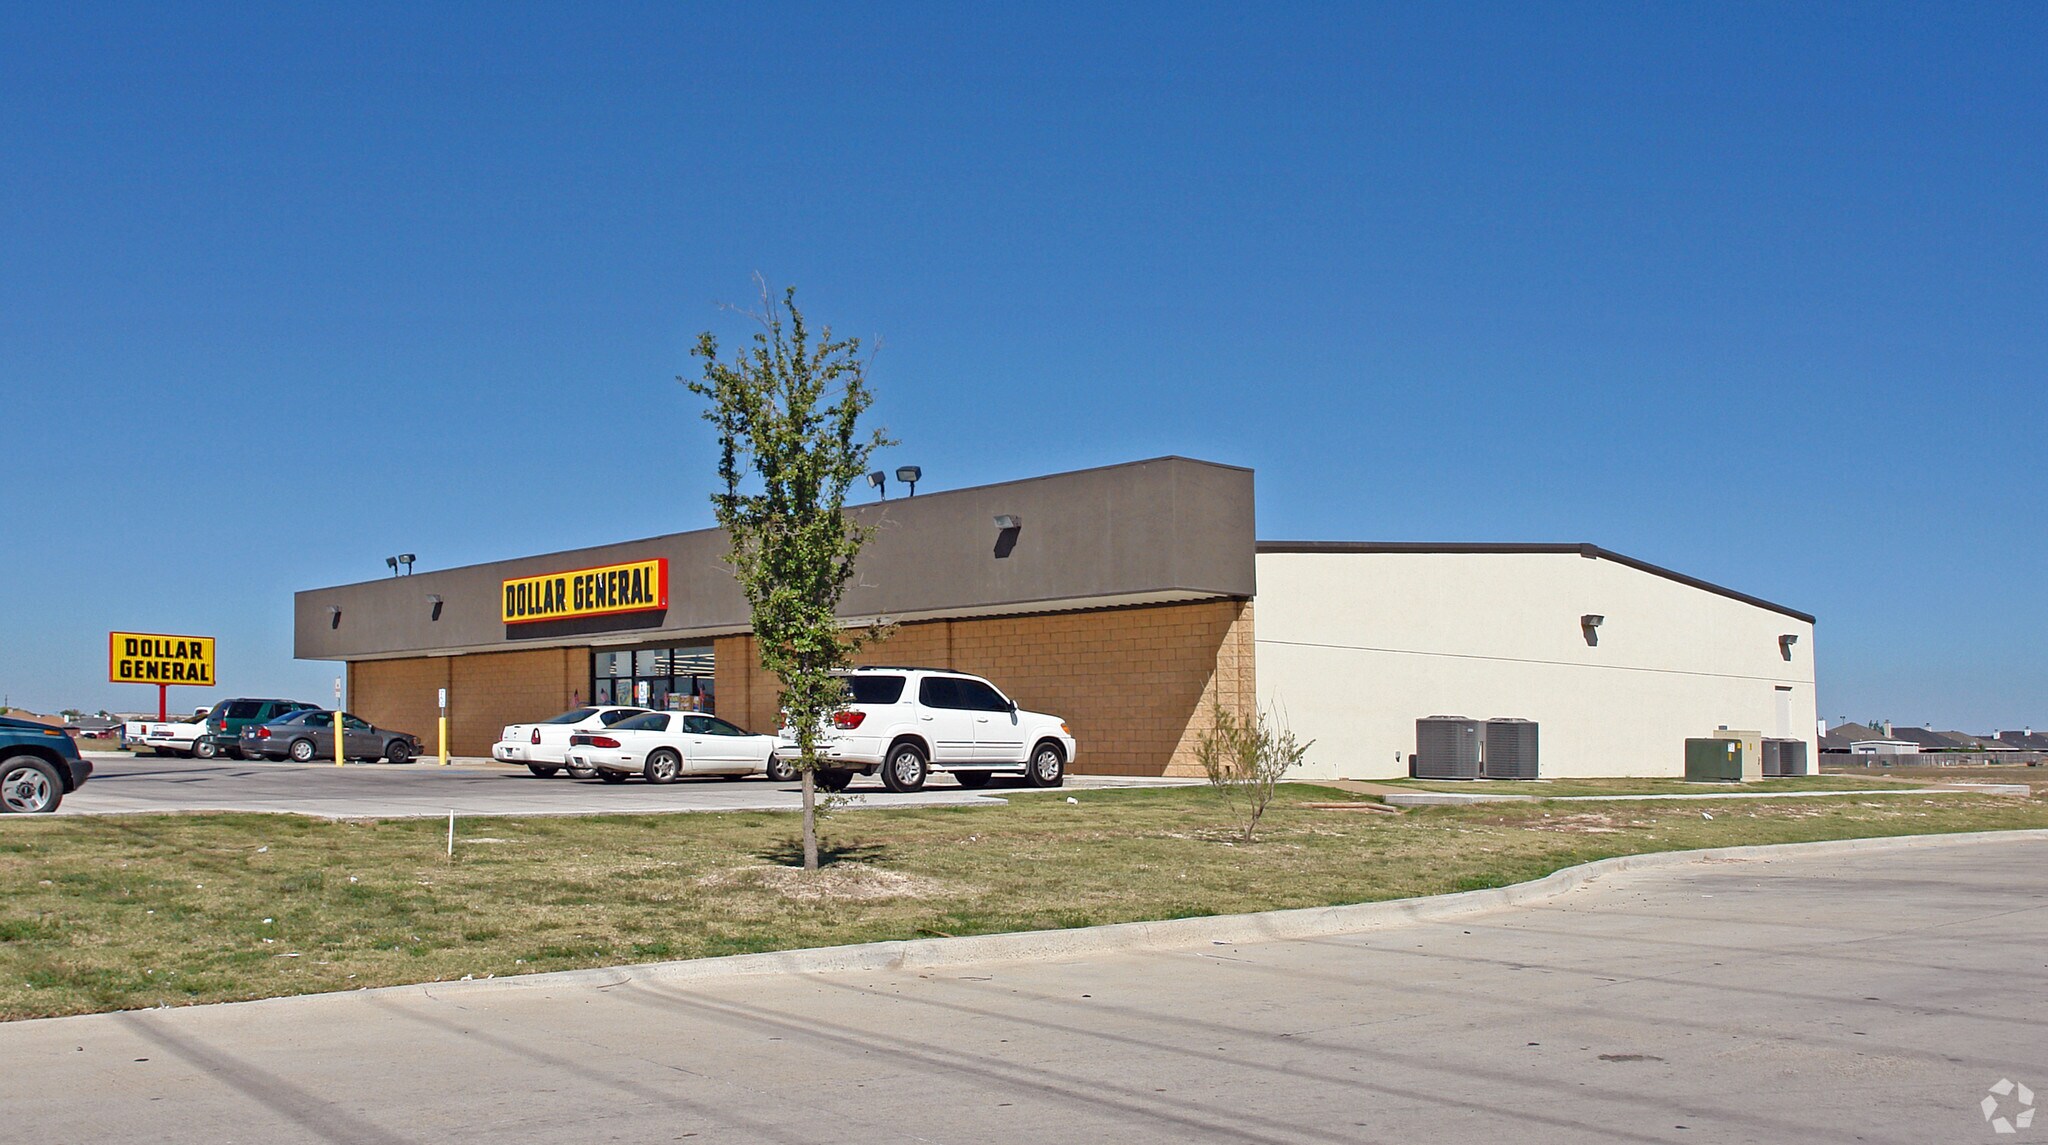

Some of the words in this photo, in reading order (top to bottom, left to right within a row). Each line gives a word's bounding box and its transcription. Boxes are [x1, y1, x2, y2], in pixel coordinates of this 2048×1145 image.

[506, 578, 567, 617] DOLLAR
[573, 566, 653, 610] GENERAL
[125, 638, 203, 660] DOLLAR
[120, 659, 209, 681] GENERAL
